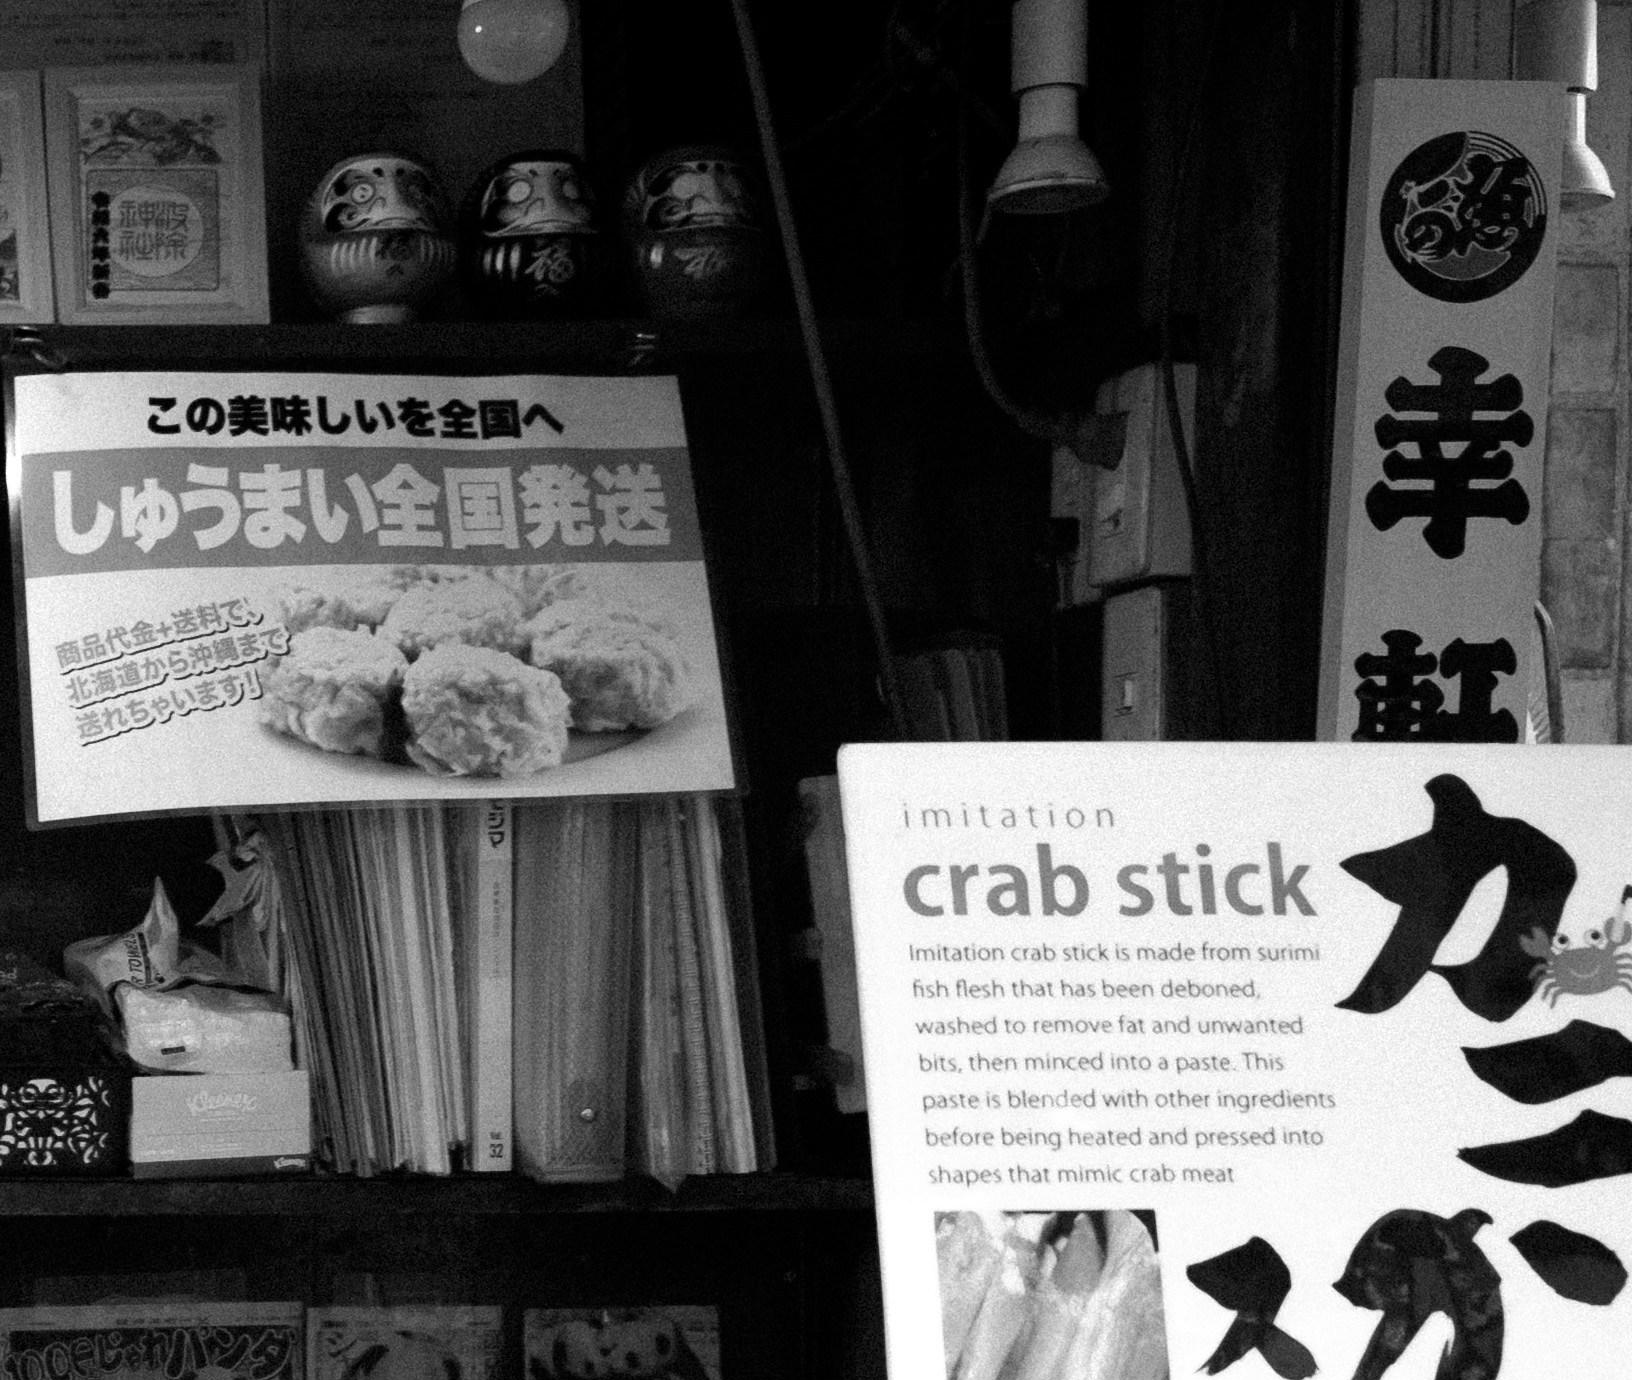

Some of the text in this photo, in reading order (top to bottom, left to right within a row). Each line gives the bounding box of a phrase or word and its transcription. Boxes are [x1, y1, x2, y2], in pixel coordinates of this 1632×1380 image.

[147, 396, 565, 440] この美味しいを全国へ
[50, 462, 673, 556] しゅうまい全国発送
[903, 802, 1115, 830] imitation
[903, 841, 1318, 918] crab stick
[909, 940, 1321, 963] Imitation crab stick is made from surimi
[912, 978, 1261, 1000] fish flesh that has been deboned,
[914, 1014, 1305, 1036] washed to remove fat and unwanted
[918, 1051, 1285, 1075] bits, then minced into a paste. This
[922, 1088, 1337, 1114] paste is blended with other ingredients
[924, 1126, 1325, 1152] before being heated and pressed into
[928, 1163, 1235, 1188] shapes that mimic crab meat
